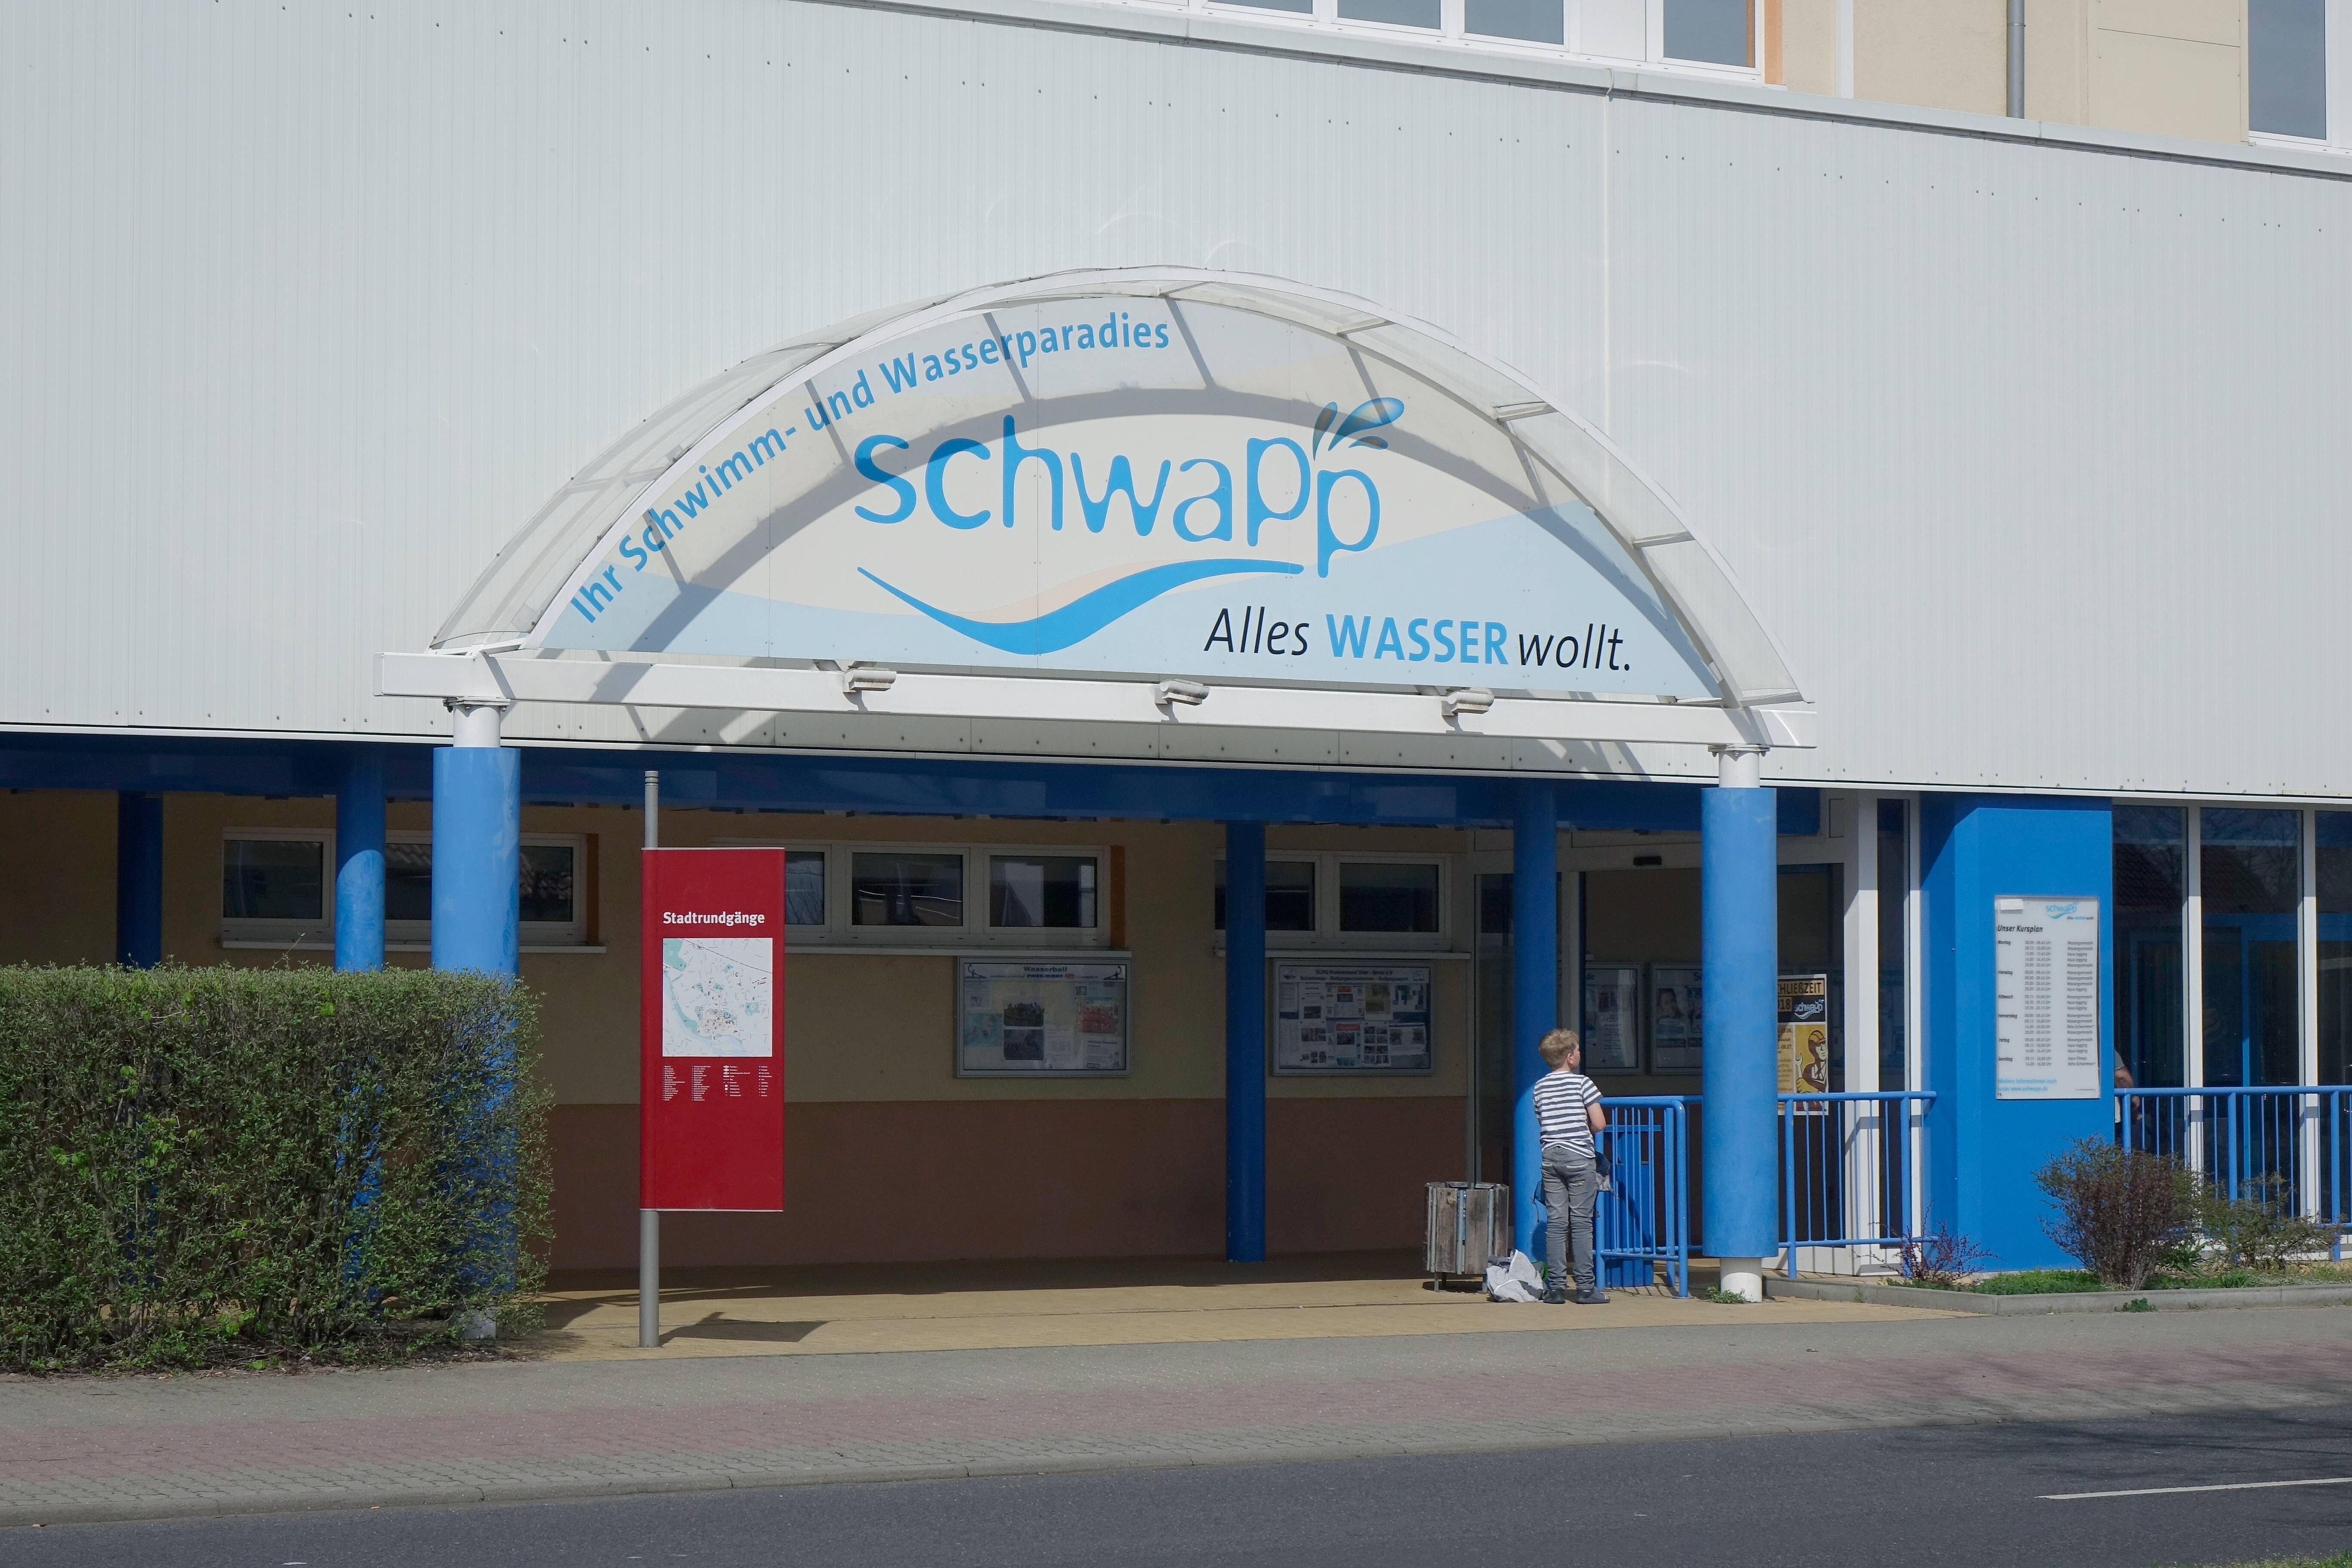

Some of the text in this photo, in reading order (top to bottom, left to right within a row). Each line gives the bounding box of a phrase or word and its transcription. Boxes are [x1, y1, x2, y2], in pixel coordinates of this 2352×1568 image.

[571, 313, 1169, 622] Ihr Schwimm- und Wasserparadies
[854, 415, 1380, 578] schwapp
[1204, 606, 1630, 671] Alles WASSER wollt.
[663, 912, 765, 926] Stadtrundgänge
[2046, 903, 2077, 913] schwapp
[2016, 925, 2043, 934] Kursplan
